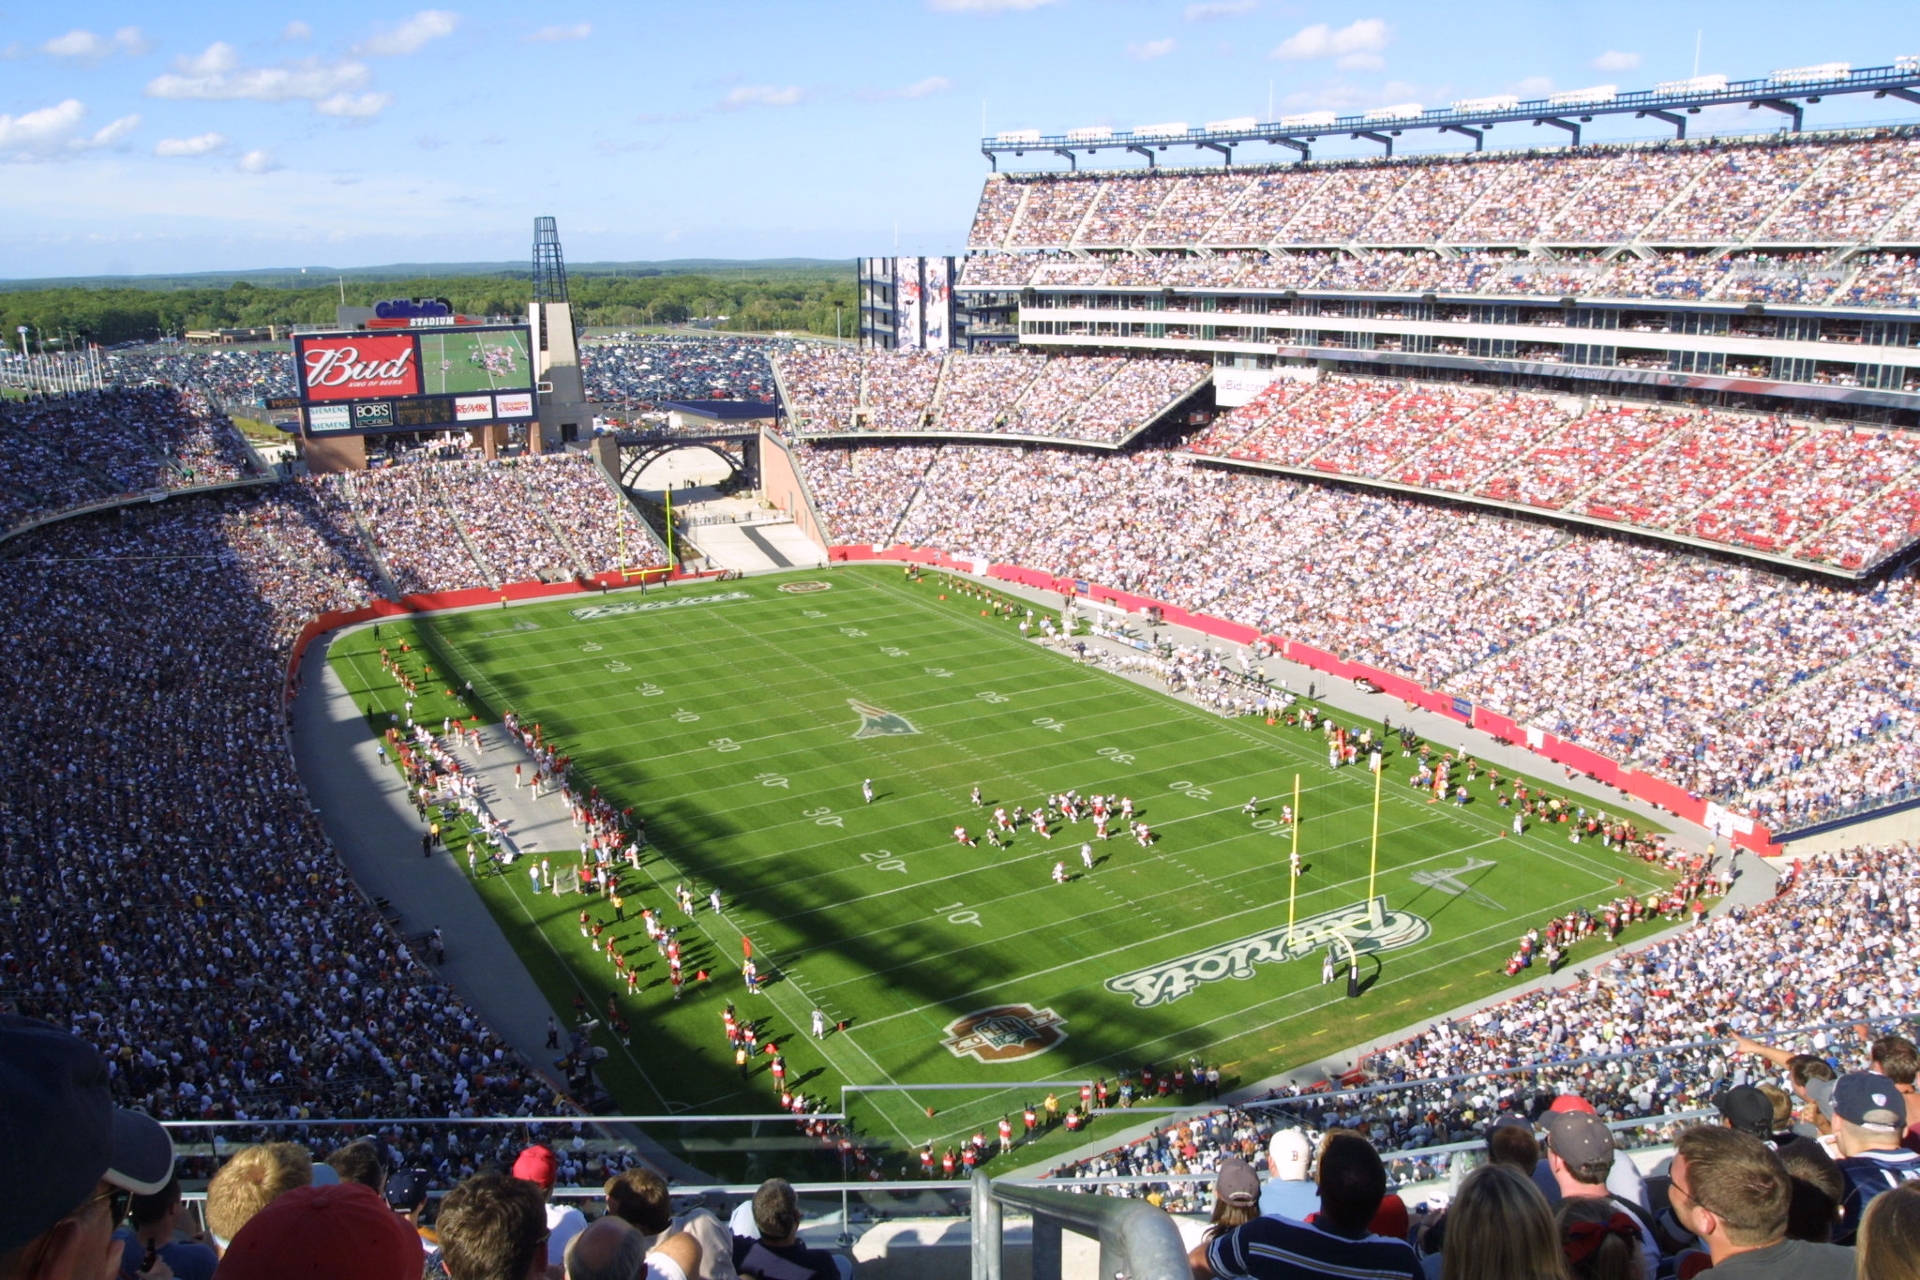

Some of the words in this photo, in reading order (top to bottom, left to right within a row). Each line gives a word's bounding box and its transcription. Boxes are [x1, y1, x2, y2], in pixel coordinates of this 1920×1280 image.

[410, 316, 455, 327] STADIUM
[304, 346, 413, 388] Bud
[309, 406, 349, 415] SIEMENS
[455, 403, 488, 413] RE/MAX
[311, 421, 351, 430] SIEMENS
[604, 661, 632, 673] 20
[635, 683, 664, 696] 30
[976, 691, 1009, 704] 50
[708, 737, 742, 752] 50
[1096, 747, 1136, 763] 30
[754, 772, 788, 787] 40
[1168, 781, 1213, 798] 20
[802, 806, 843, 826] 30
[860, 850, 906, 871] 20
[933, 902, 979, 924] 10
[1105, 895, 1431, 1008] Patriots
[1291, 1150, 1299, 1162] B
